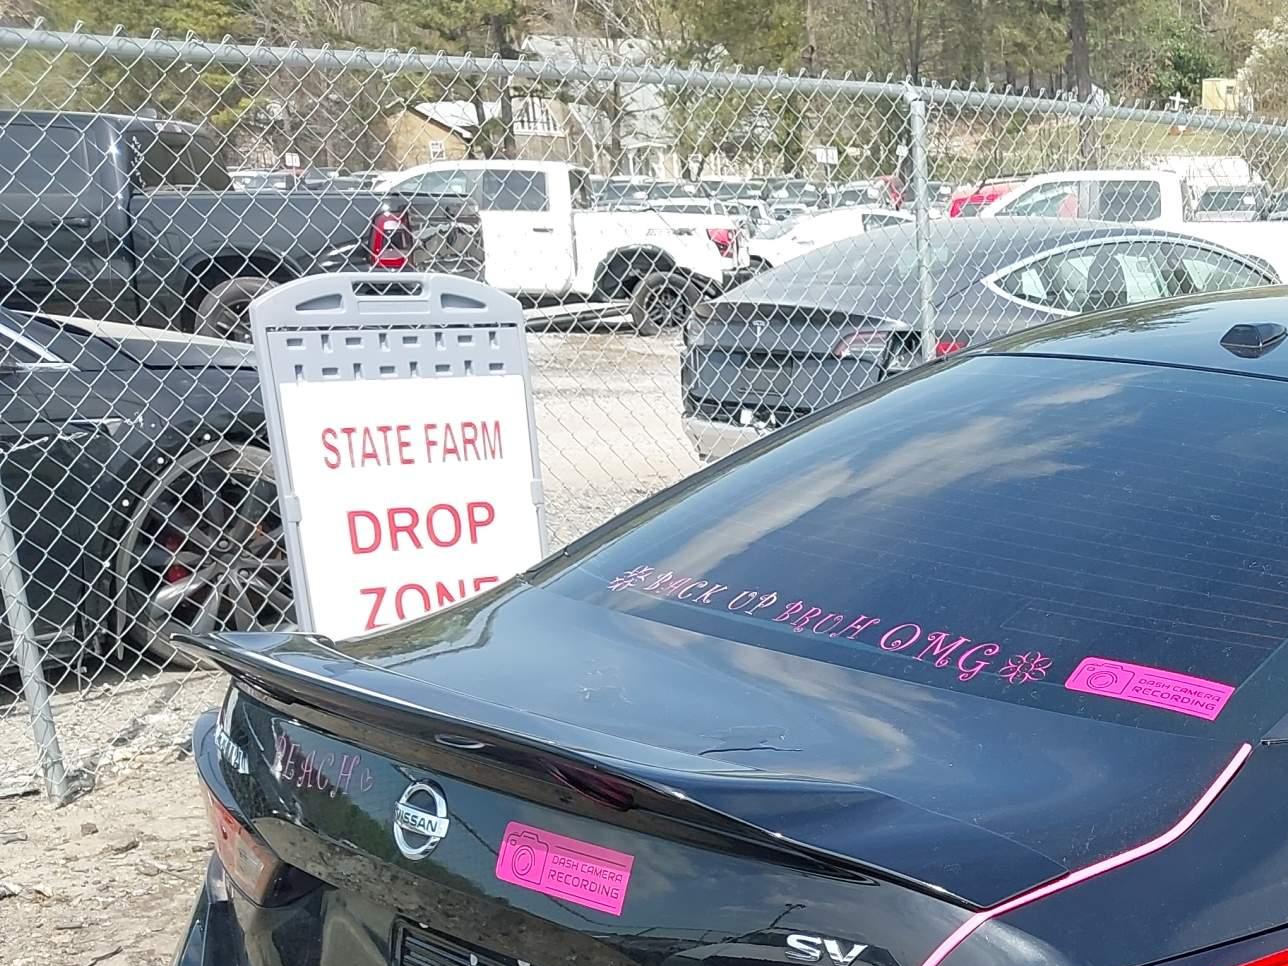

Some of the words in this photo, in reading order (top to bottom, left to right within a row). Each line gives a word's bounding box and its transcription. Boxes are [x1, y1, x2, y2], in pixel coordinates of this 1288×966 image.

[321, 424, 415, 470] STATE
[423, 420, 504, 464] FARM
[346, 501, 496, 555] DROP
[643, 571, 728, 605] BACK
[771, 600, 881, 641] BRUH
[879, 622, 1000, 682] OMG
[1130, 686, 1216, 712] RECORDING
[1137, 677, 1172, 692] DASH
[1170, 683, 1222, 703] CAMERA
[546, 869, 621, 900] RECORDING
[551, 854, 580, 872] DASH
[580, 863, 624, 884] CAMERA
